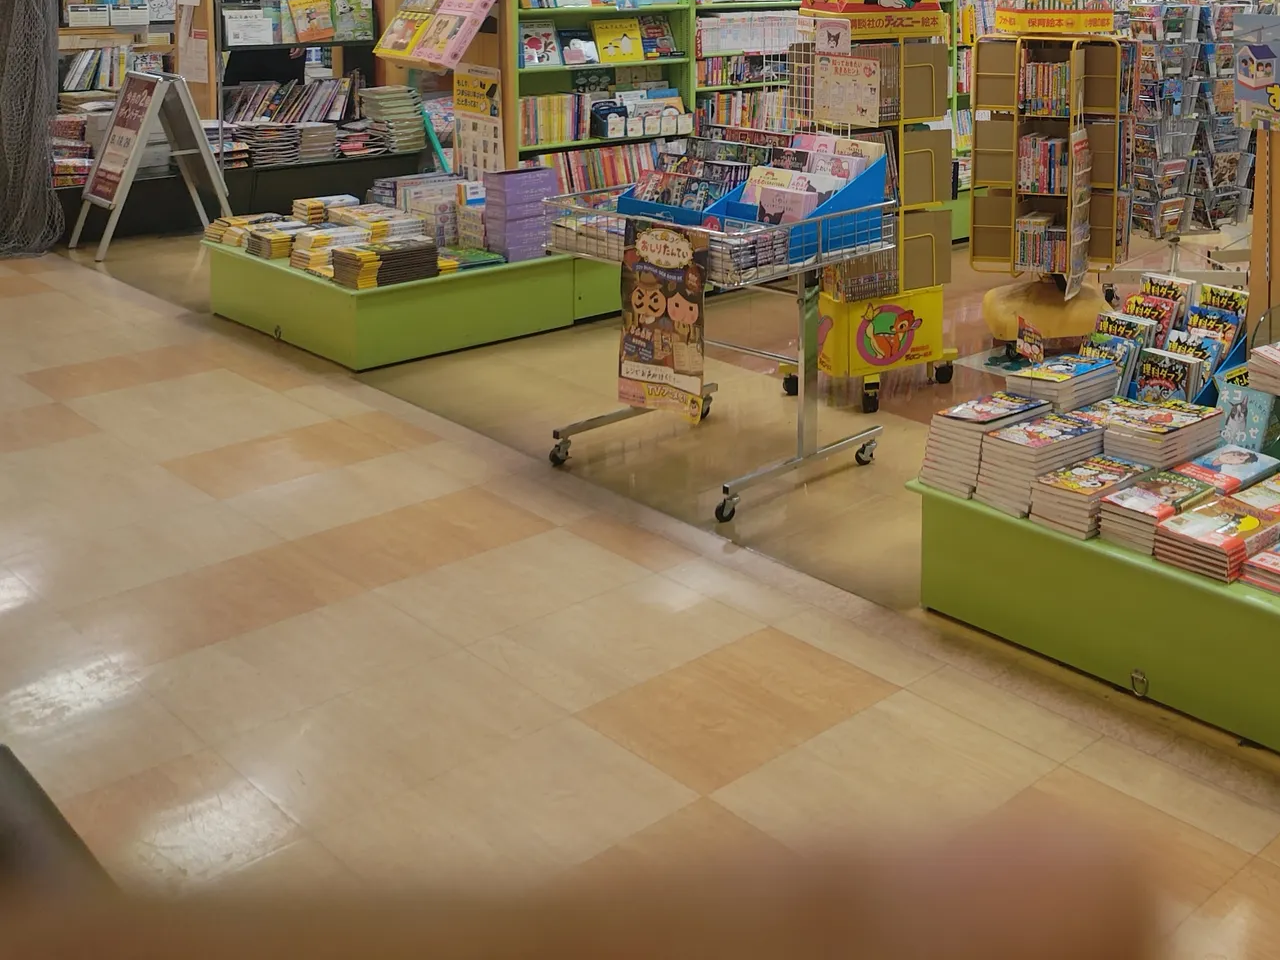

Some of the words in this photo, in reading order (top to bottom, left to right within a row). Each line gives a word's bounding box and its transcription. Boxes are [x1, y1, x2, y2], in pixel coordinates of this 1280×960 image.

[1026, 18, 1064, 28] 保育絵本
[640, 240, 689, 260] おしりたんてい
[1126, 300, 1168, 319] 理科ダマン
[1189, 313, 1232, 332] 理科ダマン
[1142, 362, 1183, 383] 理科ダマン
[1221, 389, 1247, 403] ネコ
